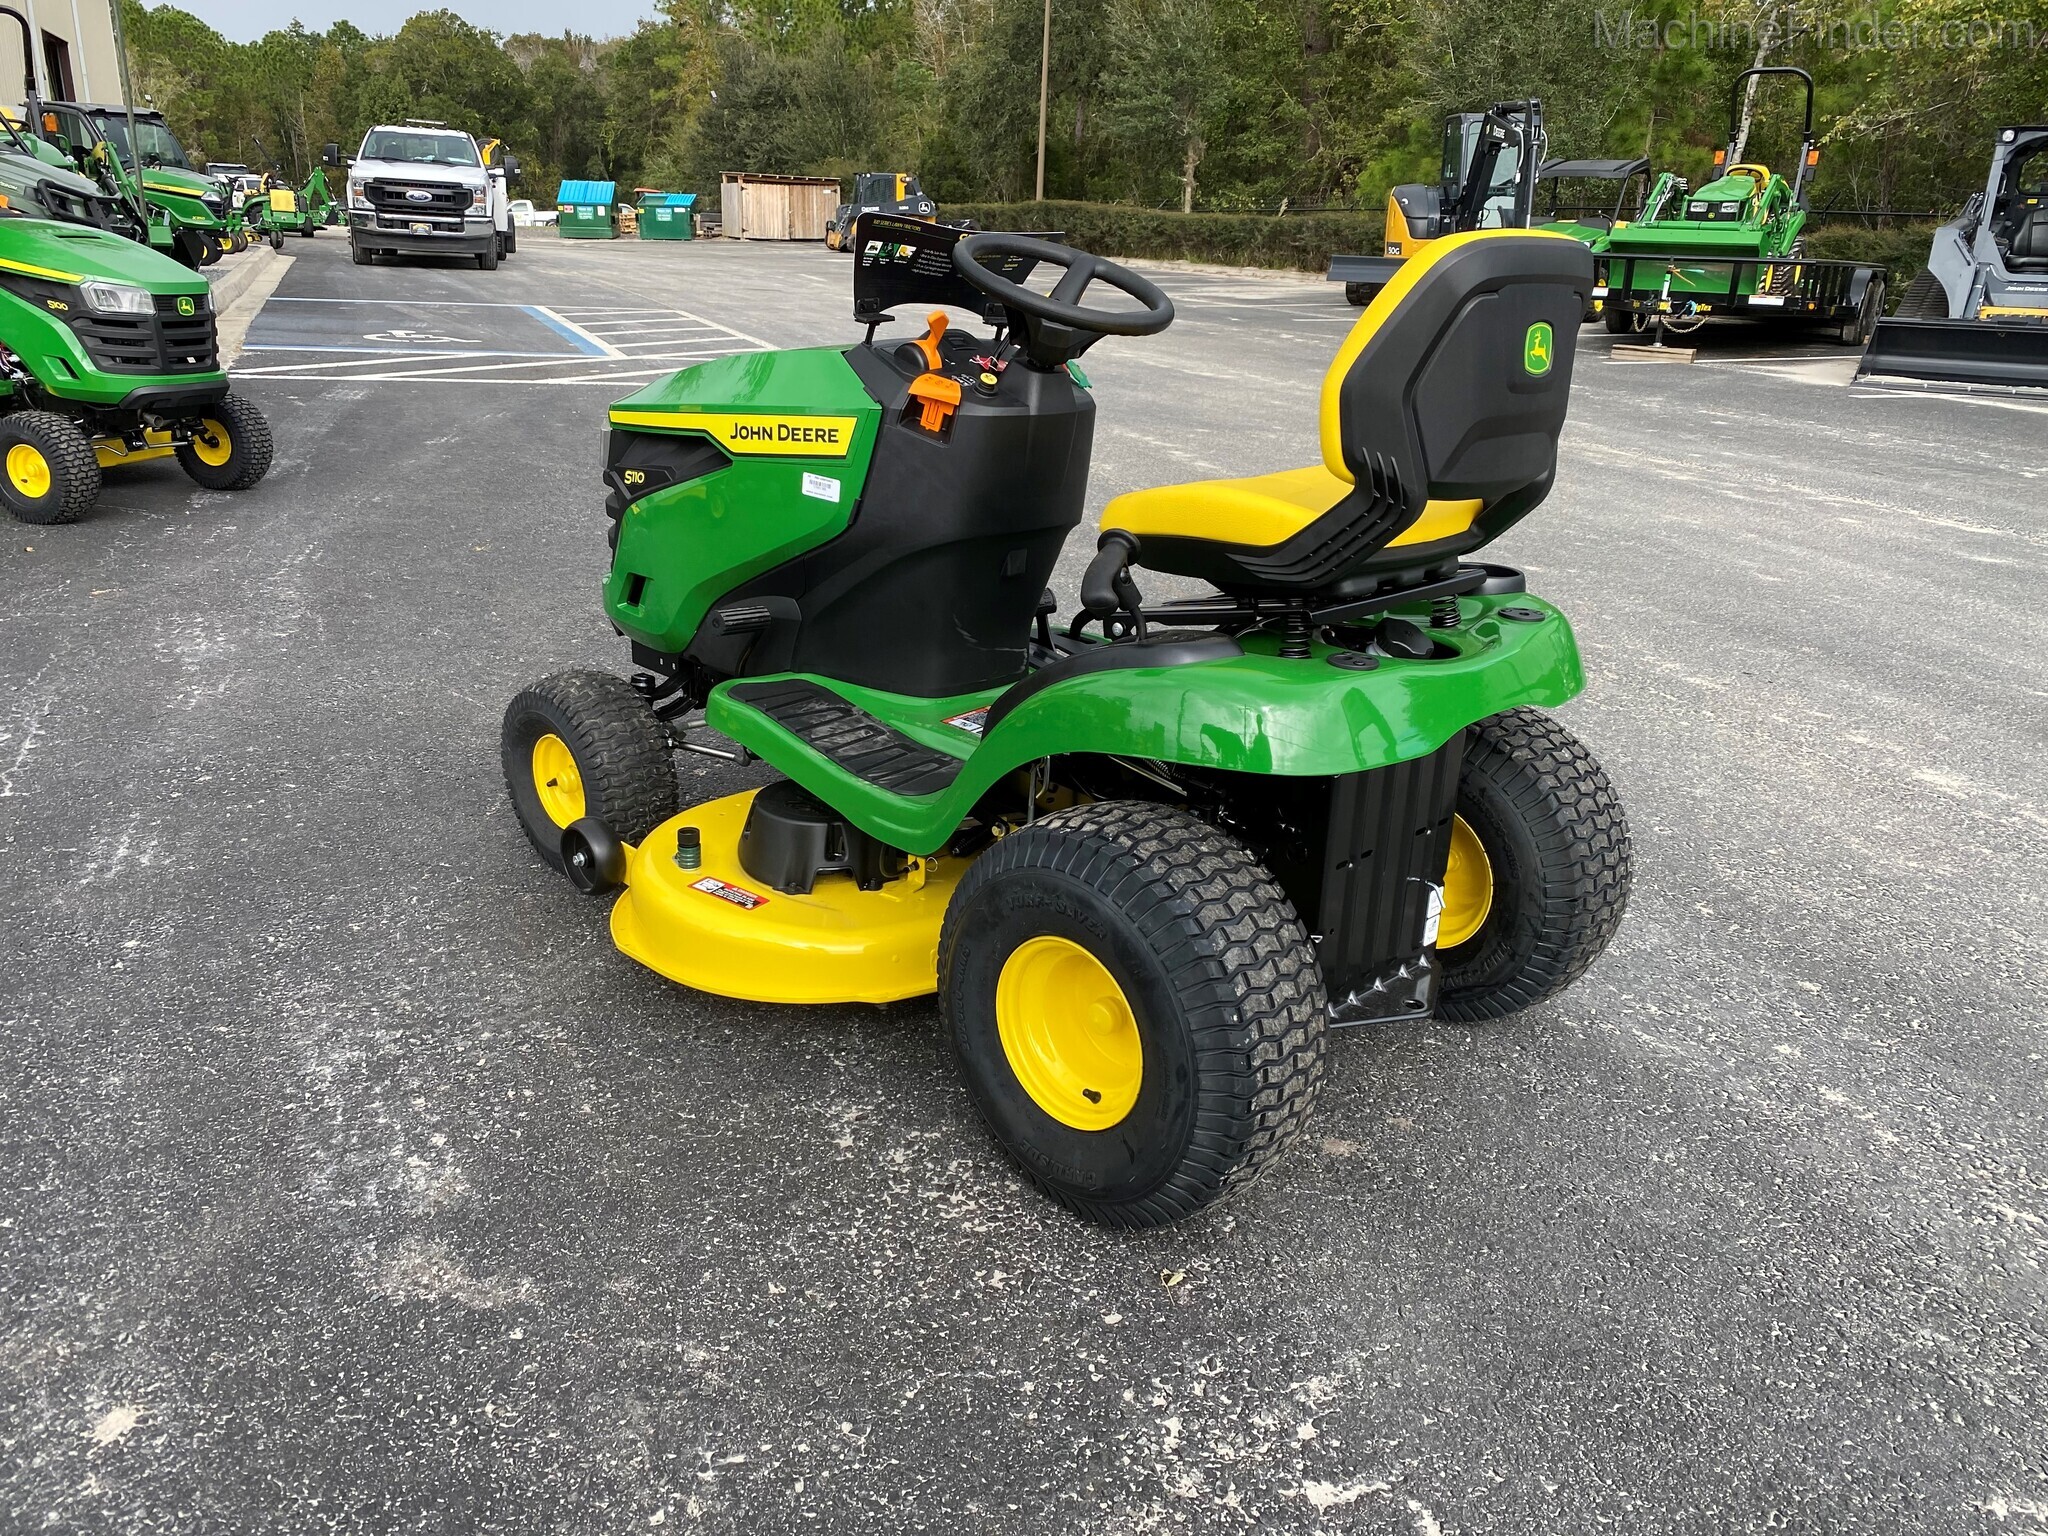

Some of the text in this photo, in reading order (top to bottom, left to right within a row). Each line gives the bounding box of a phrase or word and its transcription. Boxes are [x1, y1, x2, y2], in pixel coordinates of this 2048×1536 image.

[1388, 246, 1400, 255] 50G
[46, 299, 69, 311] S100
[730, 422, 839, 443] JOHN DEERE
[624, 470, 645, 485] S110
